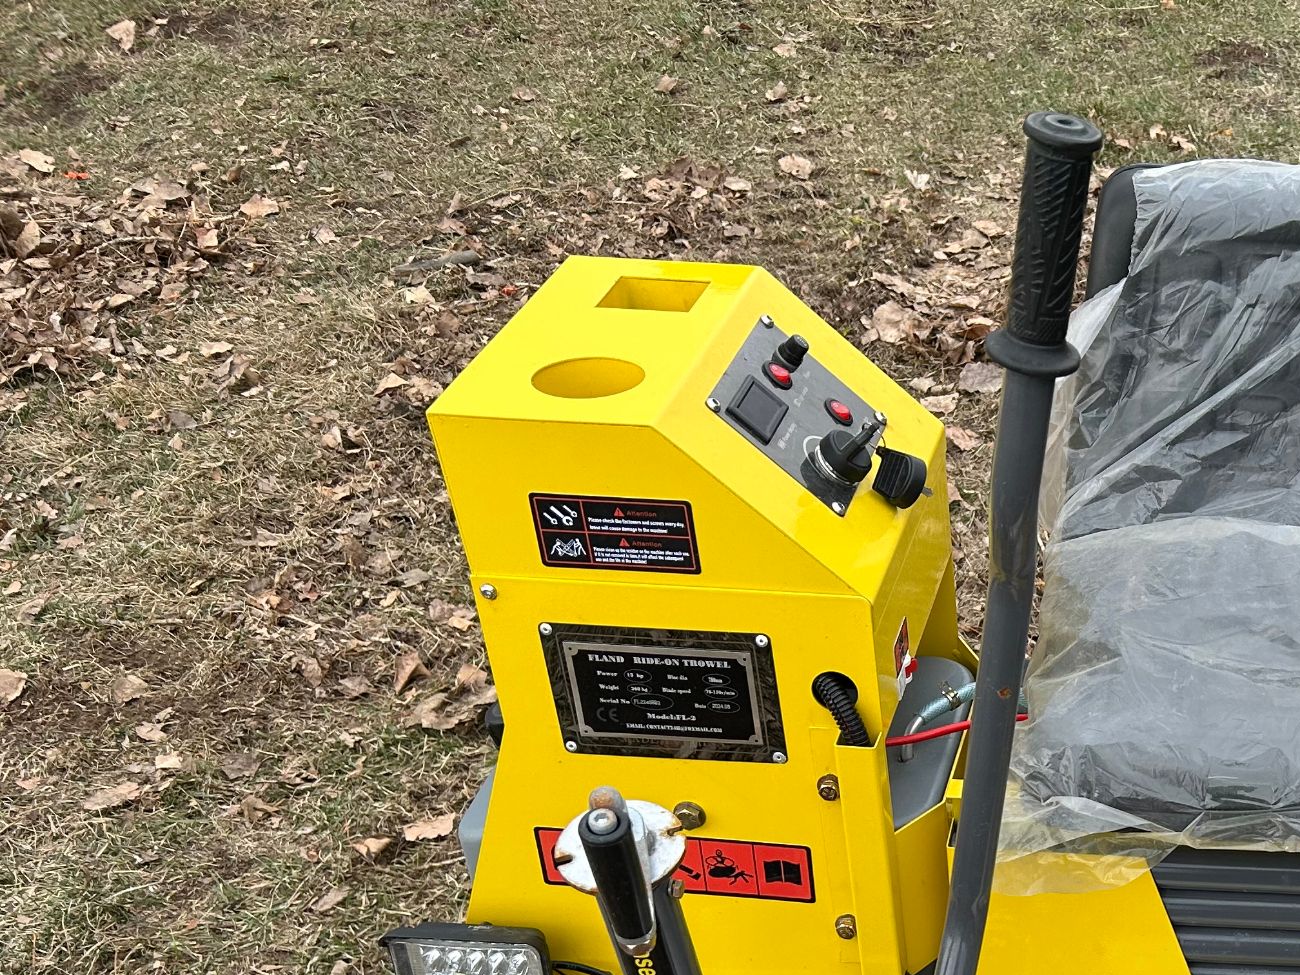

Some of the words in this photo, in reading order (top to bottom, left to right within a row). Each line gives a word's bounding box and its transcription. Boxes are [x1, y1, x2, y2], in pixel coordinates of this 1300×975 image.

[626, 509, 656, 517] Attention
[632, 540, 662, 548] Attention
[587, 654, 625, 663] FLAND
[633, 656, 680, 667] RIDE-ON
[681, 659, 732, 669] TROWEL
[596, 670, 618, 678] Power
